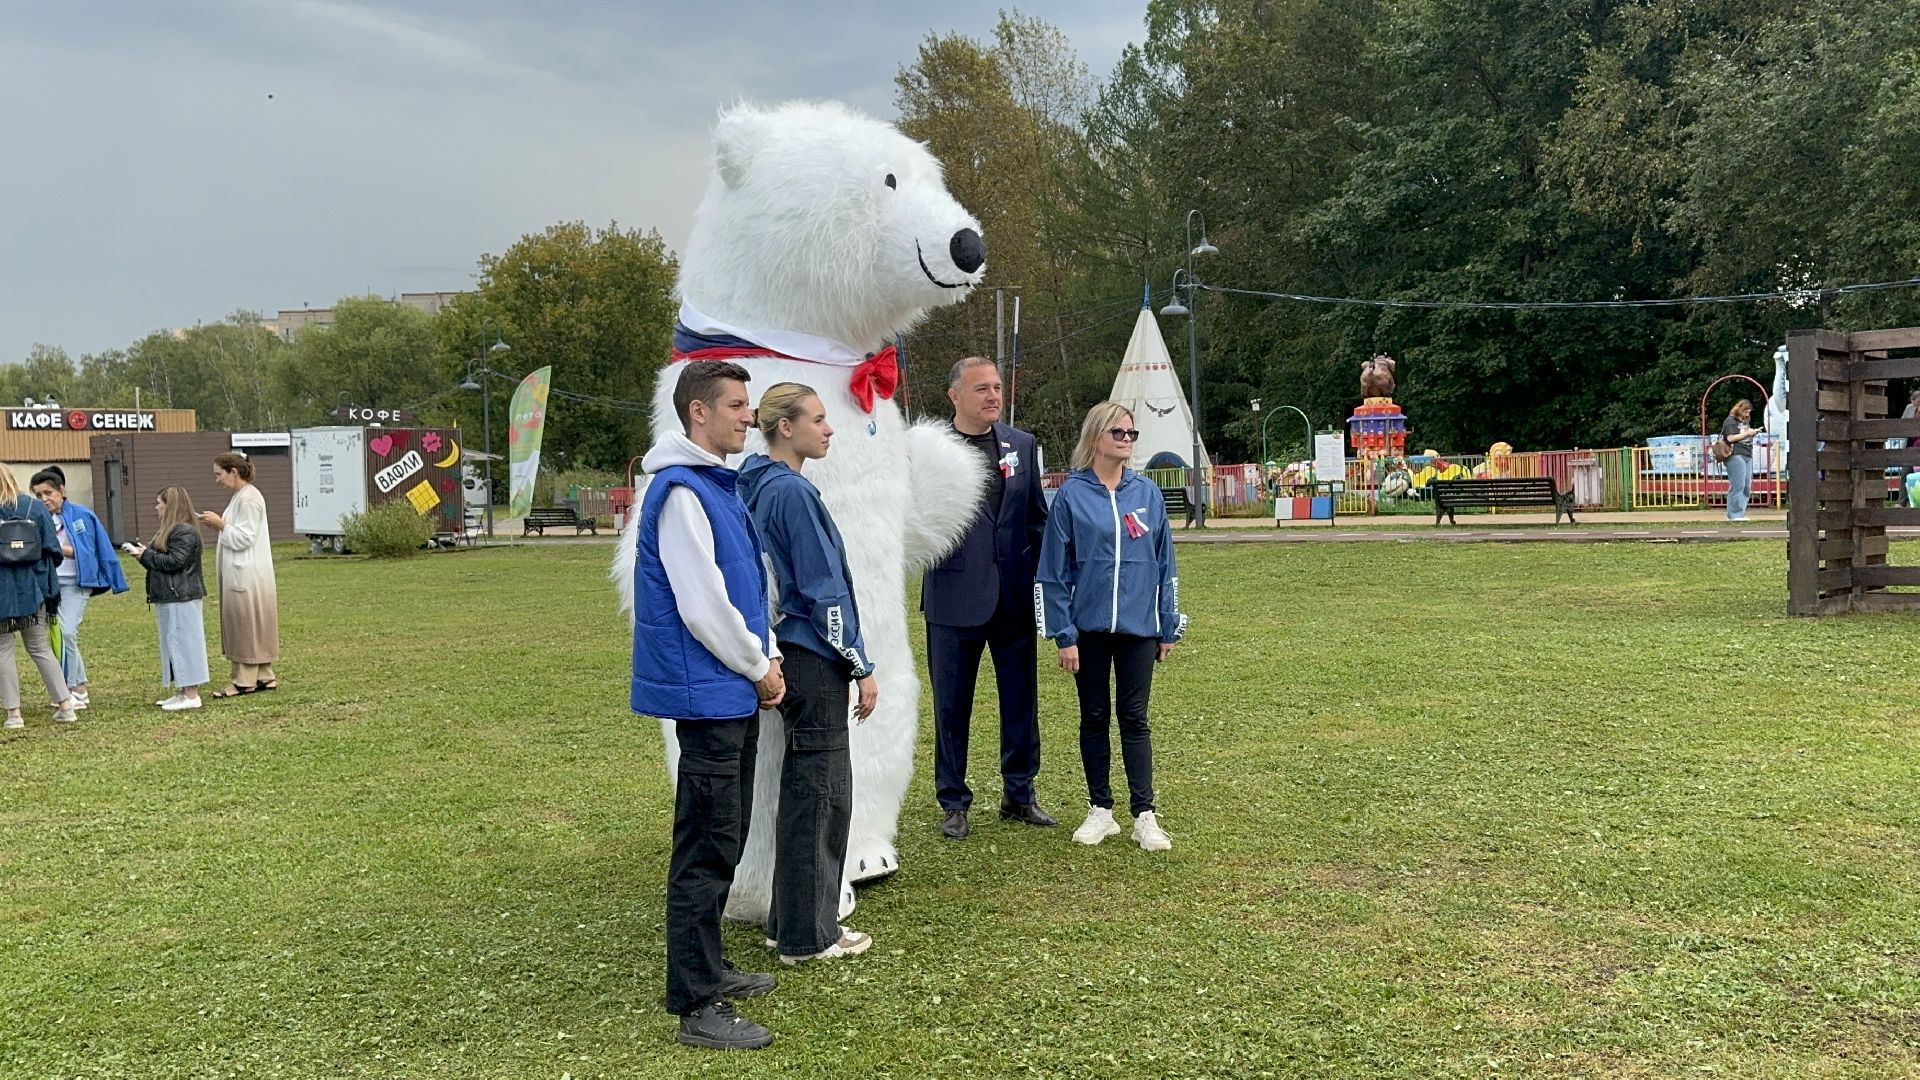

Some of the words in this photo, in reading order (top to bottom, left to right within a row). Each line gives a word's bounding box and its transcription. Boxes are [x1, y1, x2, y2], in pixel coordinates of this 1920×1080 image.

[11, 412, 62, 429] КАФЕ
[92, 413, 154, 429] СЕНЕЖ
[349, 408, 401, 421] КОФЕ
[377, 453, 420, 490] ВАФЛИ
